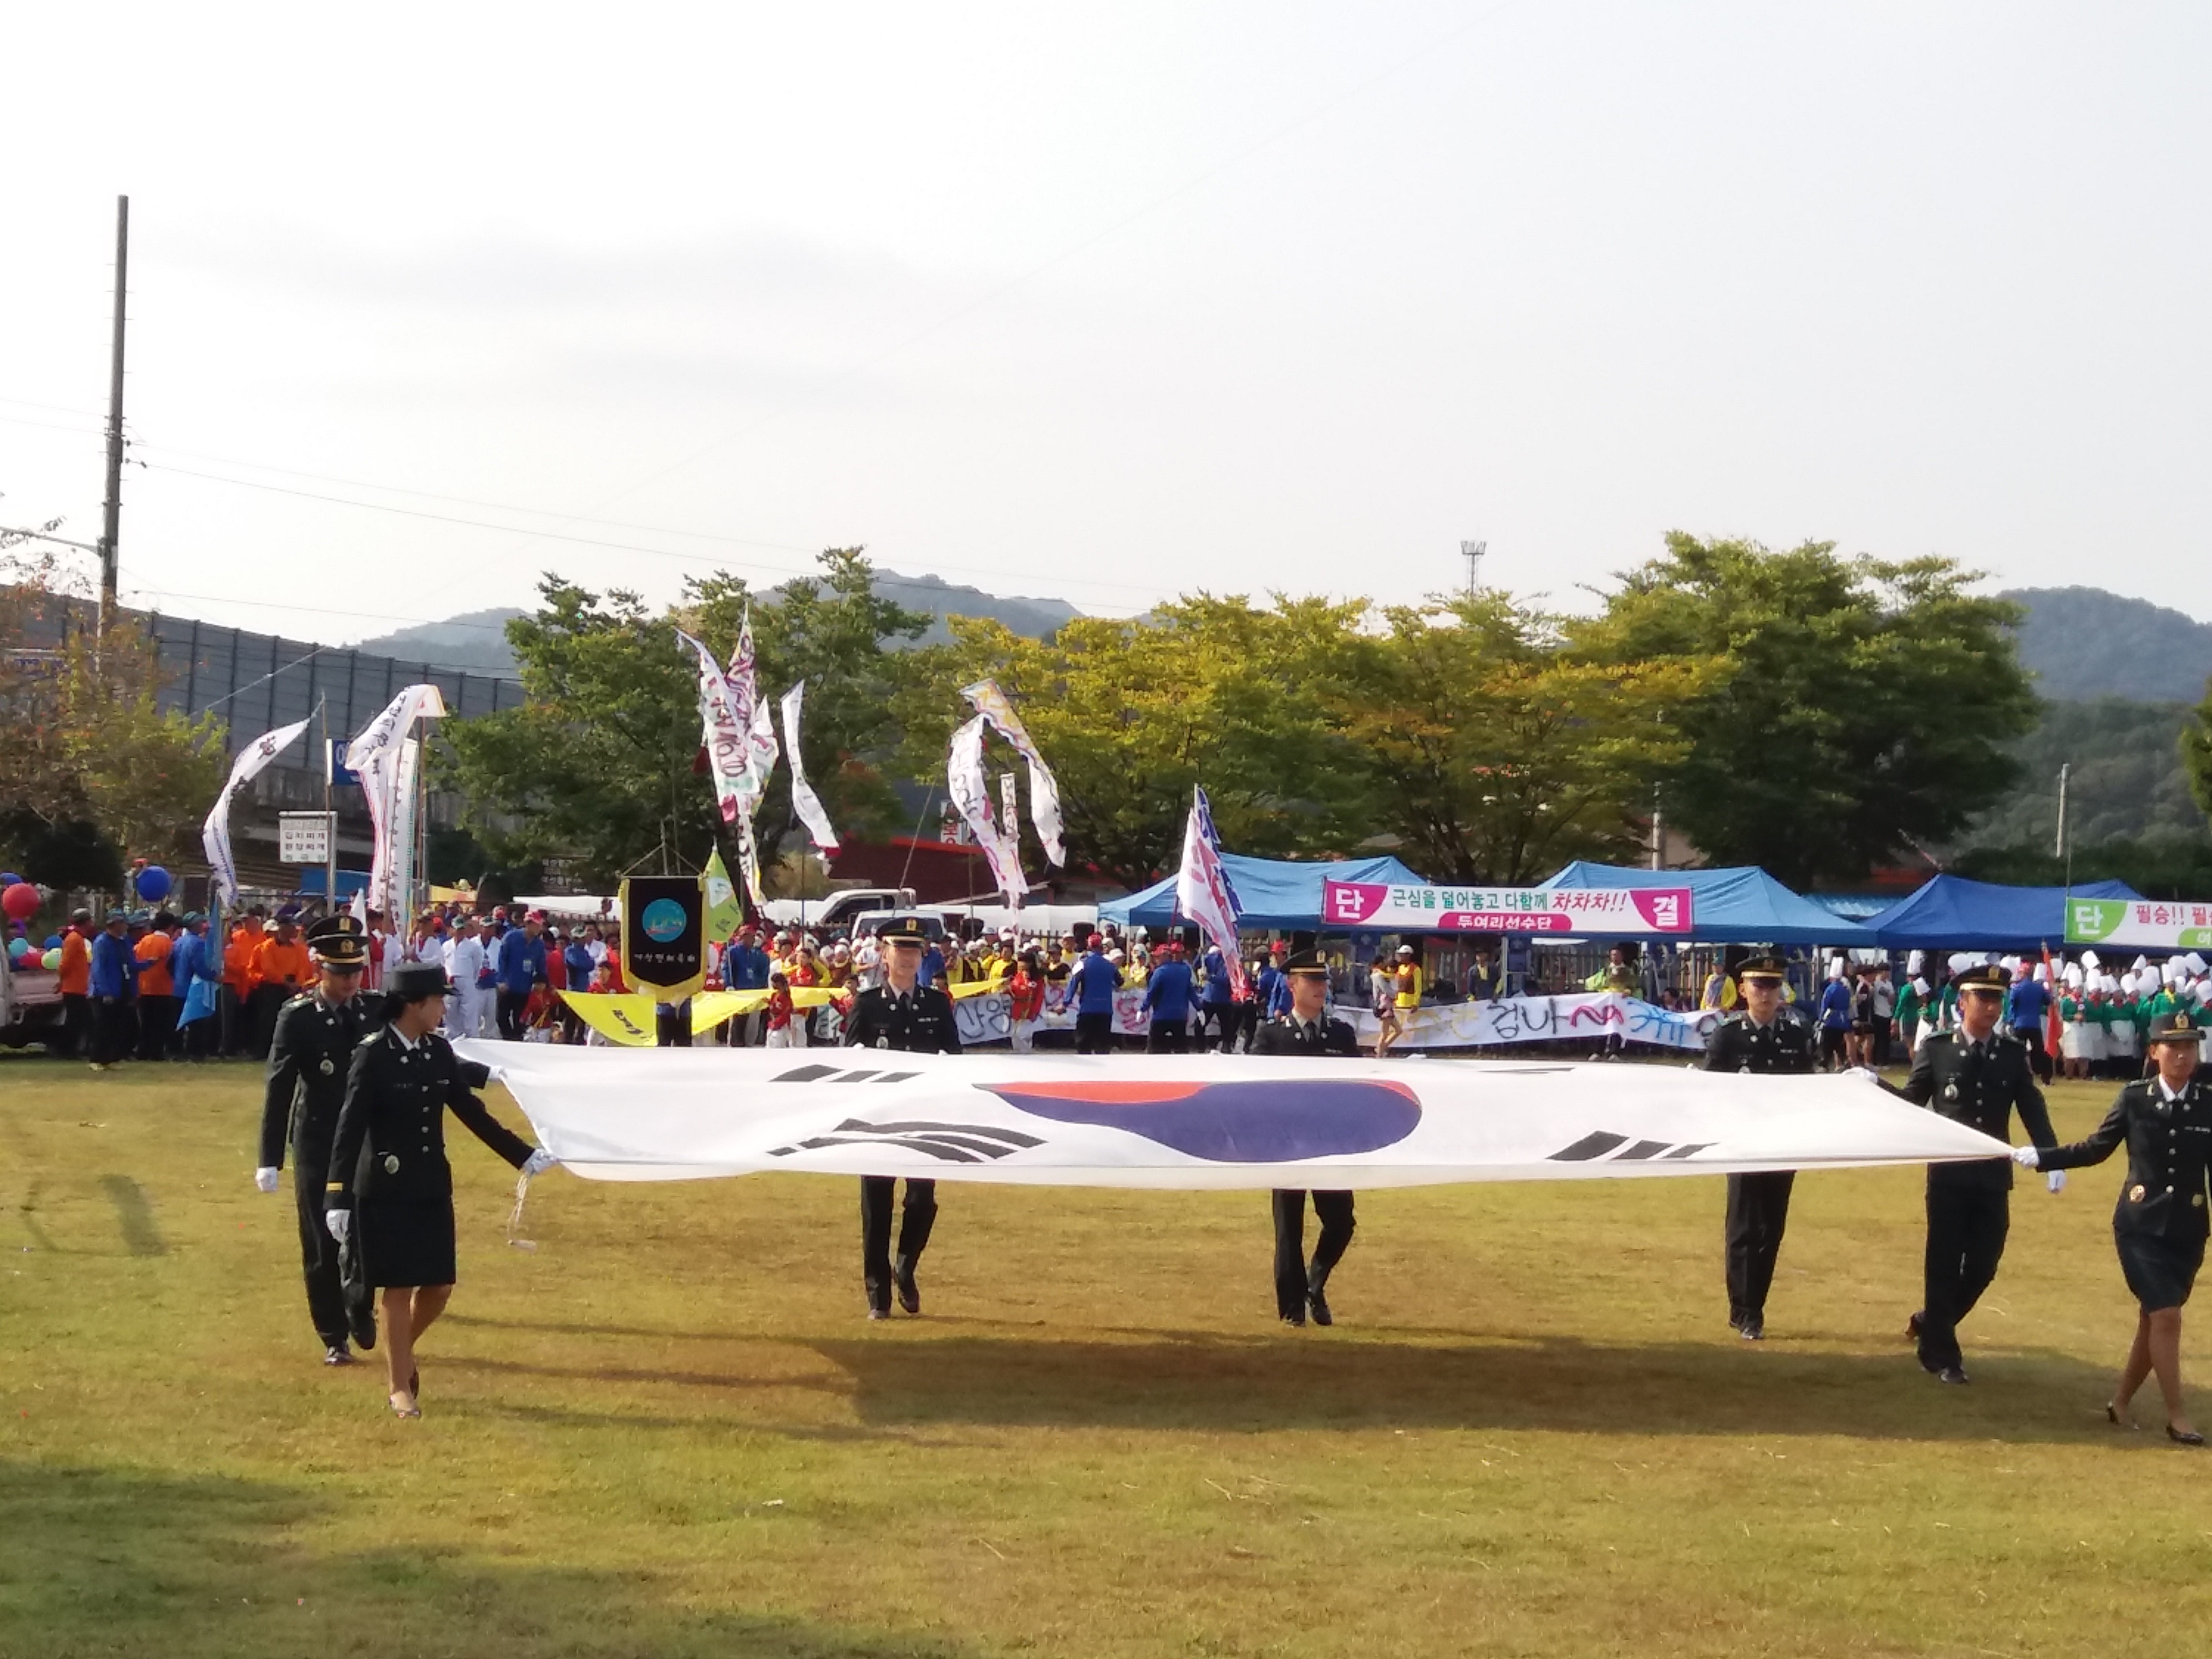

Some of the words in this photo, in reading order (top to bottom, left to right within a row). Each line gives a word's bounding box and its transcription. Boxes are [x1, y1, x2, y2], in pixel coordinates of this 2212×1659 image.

[1335, 888, 1365, 918] 단
[1393, 888, 1436, 909] 근심을
[1505, 892, 1548, 910] 다함께
[1552, 892, 1627, 911] 차차차!!
[1653, 894, 1679, 927] 결
[1457, 915, 1552, 930] 두여리선수단
[2075, 905, 2104, 934] 단
[2136, 905, 2185, 925] 필승!!
[2191, 906, 2212, 926] 필
